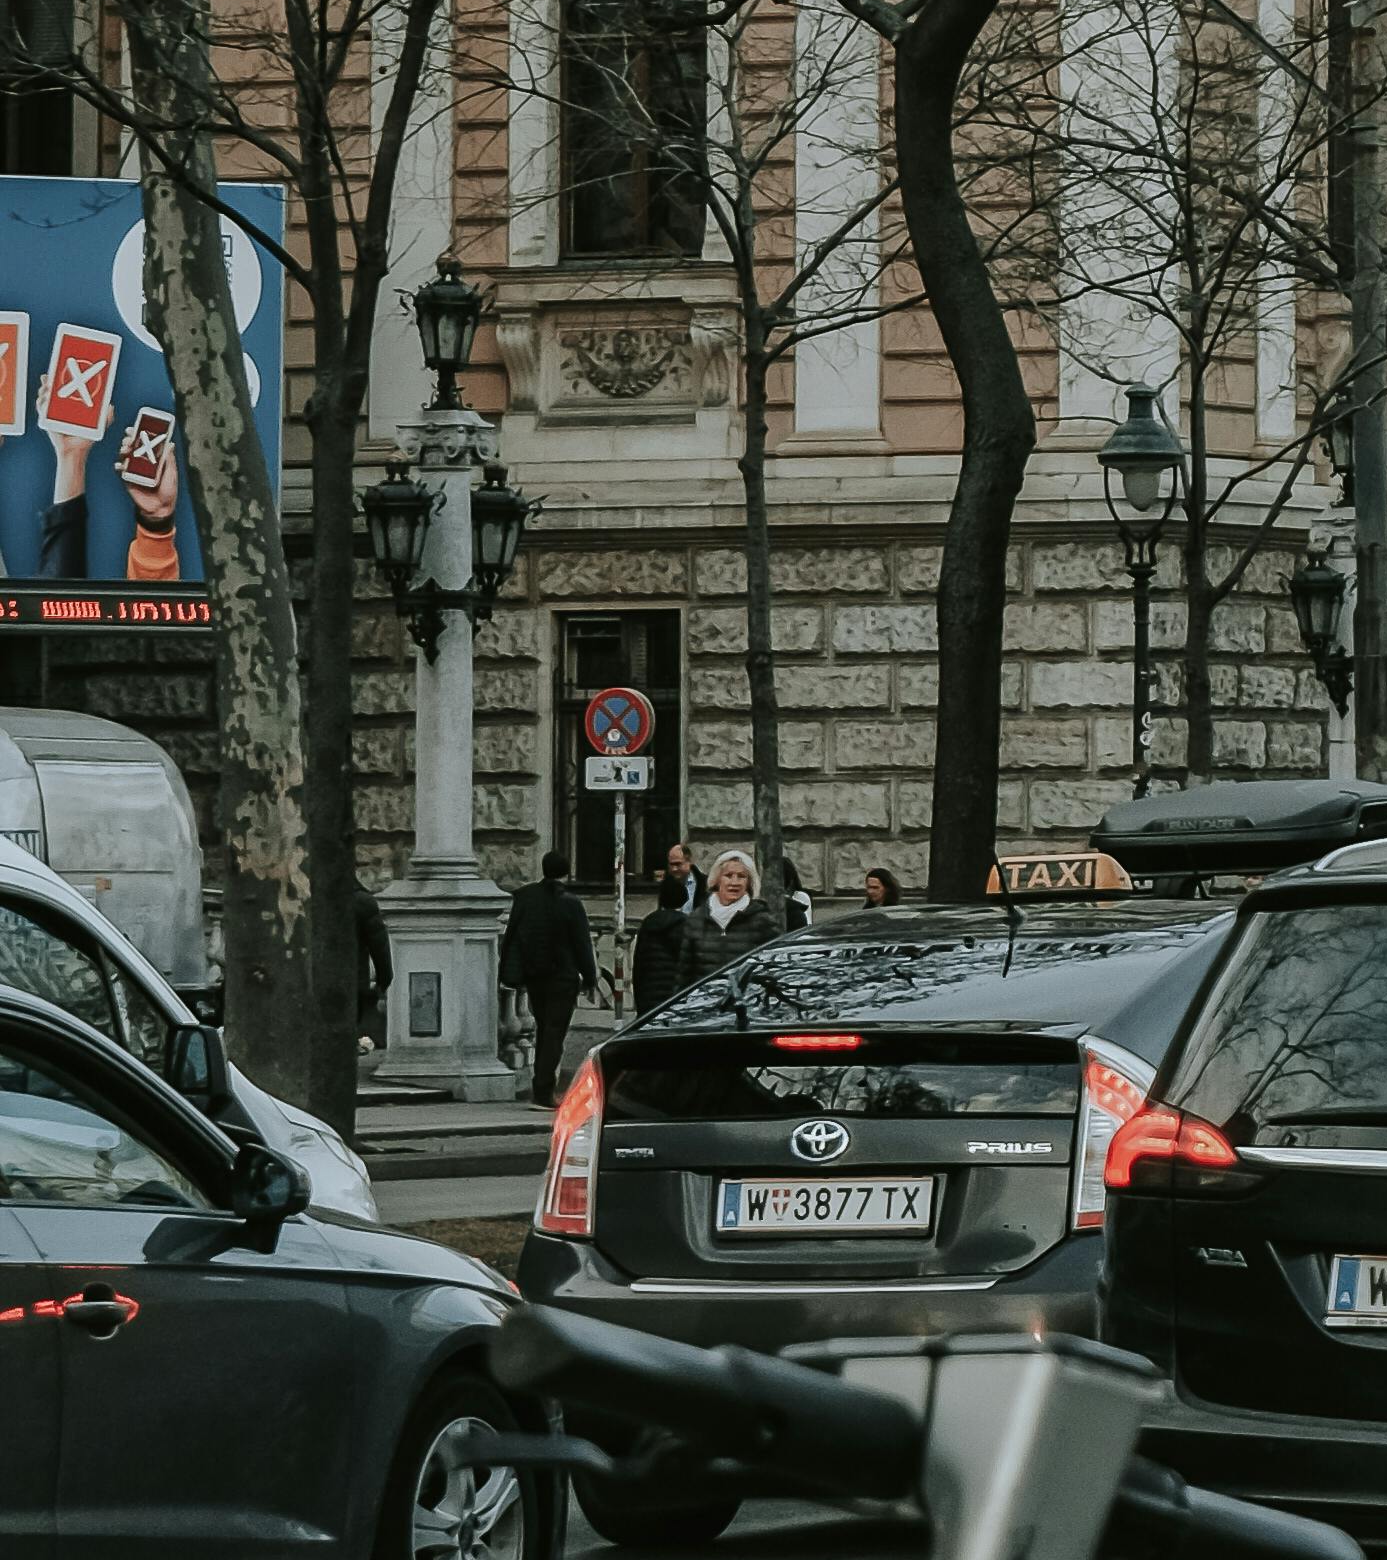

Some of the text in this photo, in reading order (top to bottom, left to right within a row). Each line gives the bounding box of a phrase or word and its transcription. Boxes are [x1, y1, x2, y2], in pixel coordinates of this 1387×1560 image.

[1004, 861, 1093, 889] TAXI
[966, 1141, 1053, 1154] PRIUS
[747, 1188, 770, 1221] W
[794, 1187, 873, 1220] 3877
[883, 1186, 921, 1219] TX
